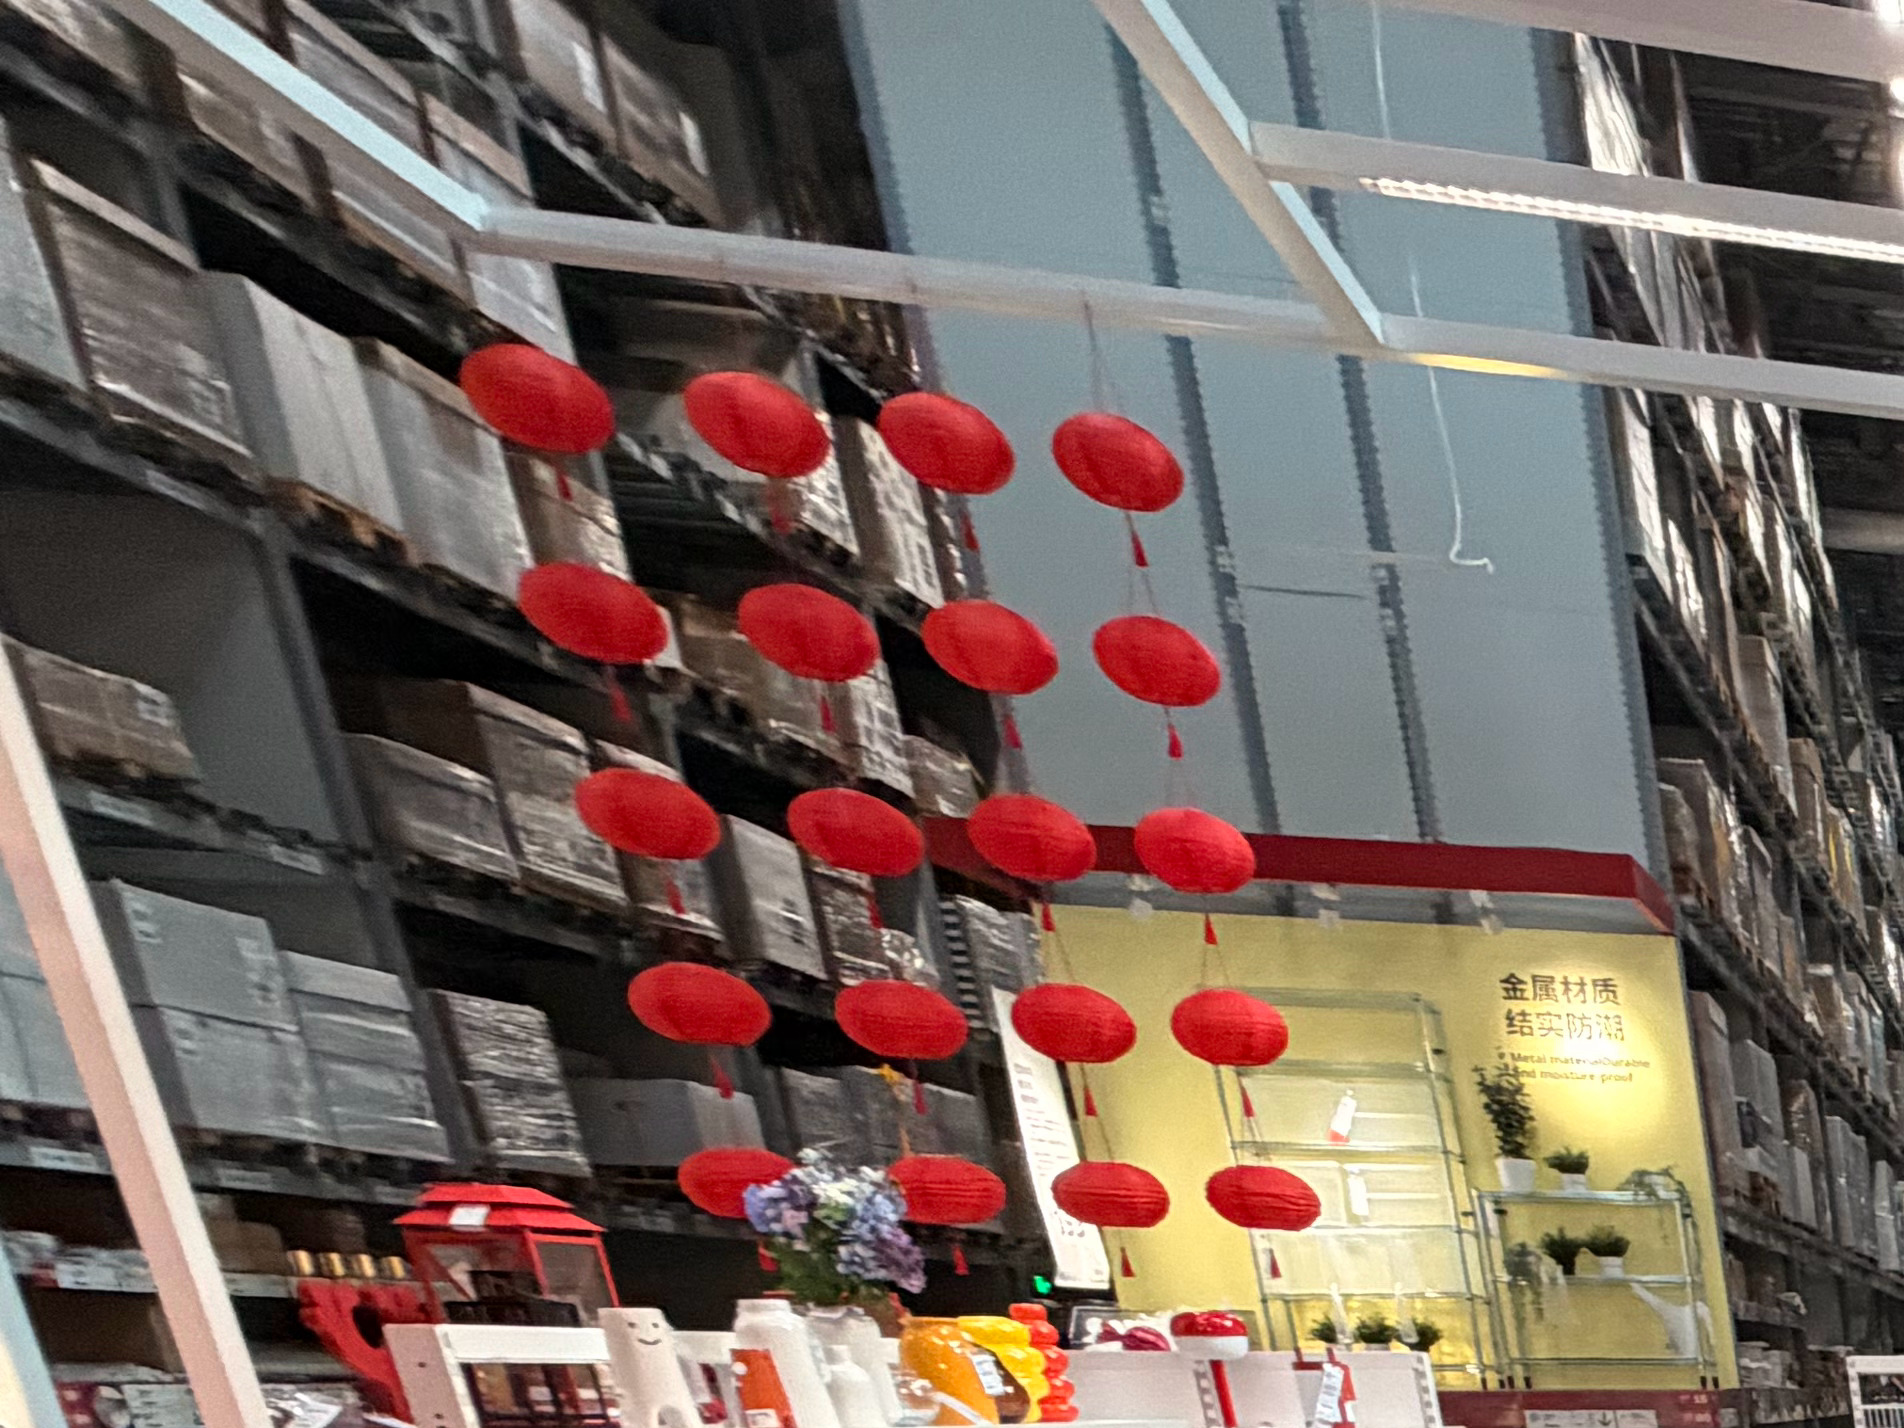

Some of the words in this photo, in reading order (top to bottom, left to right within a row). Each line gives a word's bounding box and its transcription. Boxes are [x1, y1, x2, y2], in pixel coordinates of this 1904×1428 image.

[1499, 972, 1621, 1005] 金属材质
[1505, 1008, 1625, 1041] 结实防潮
